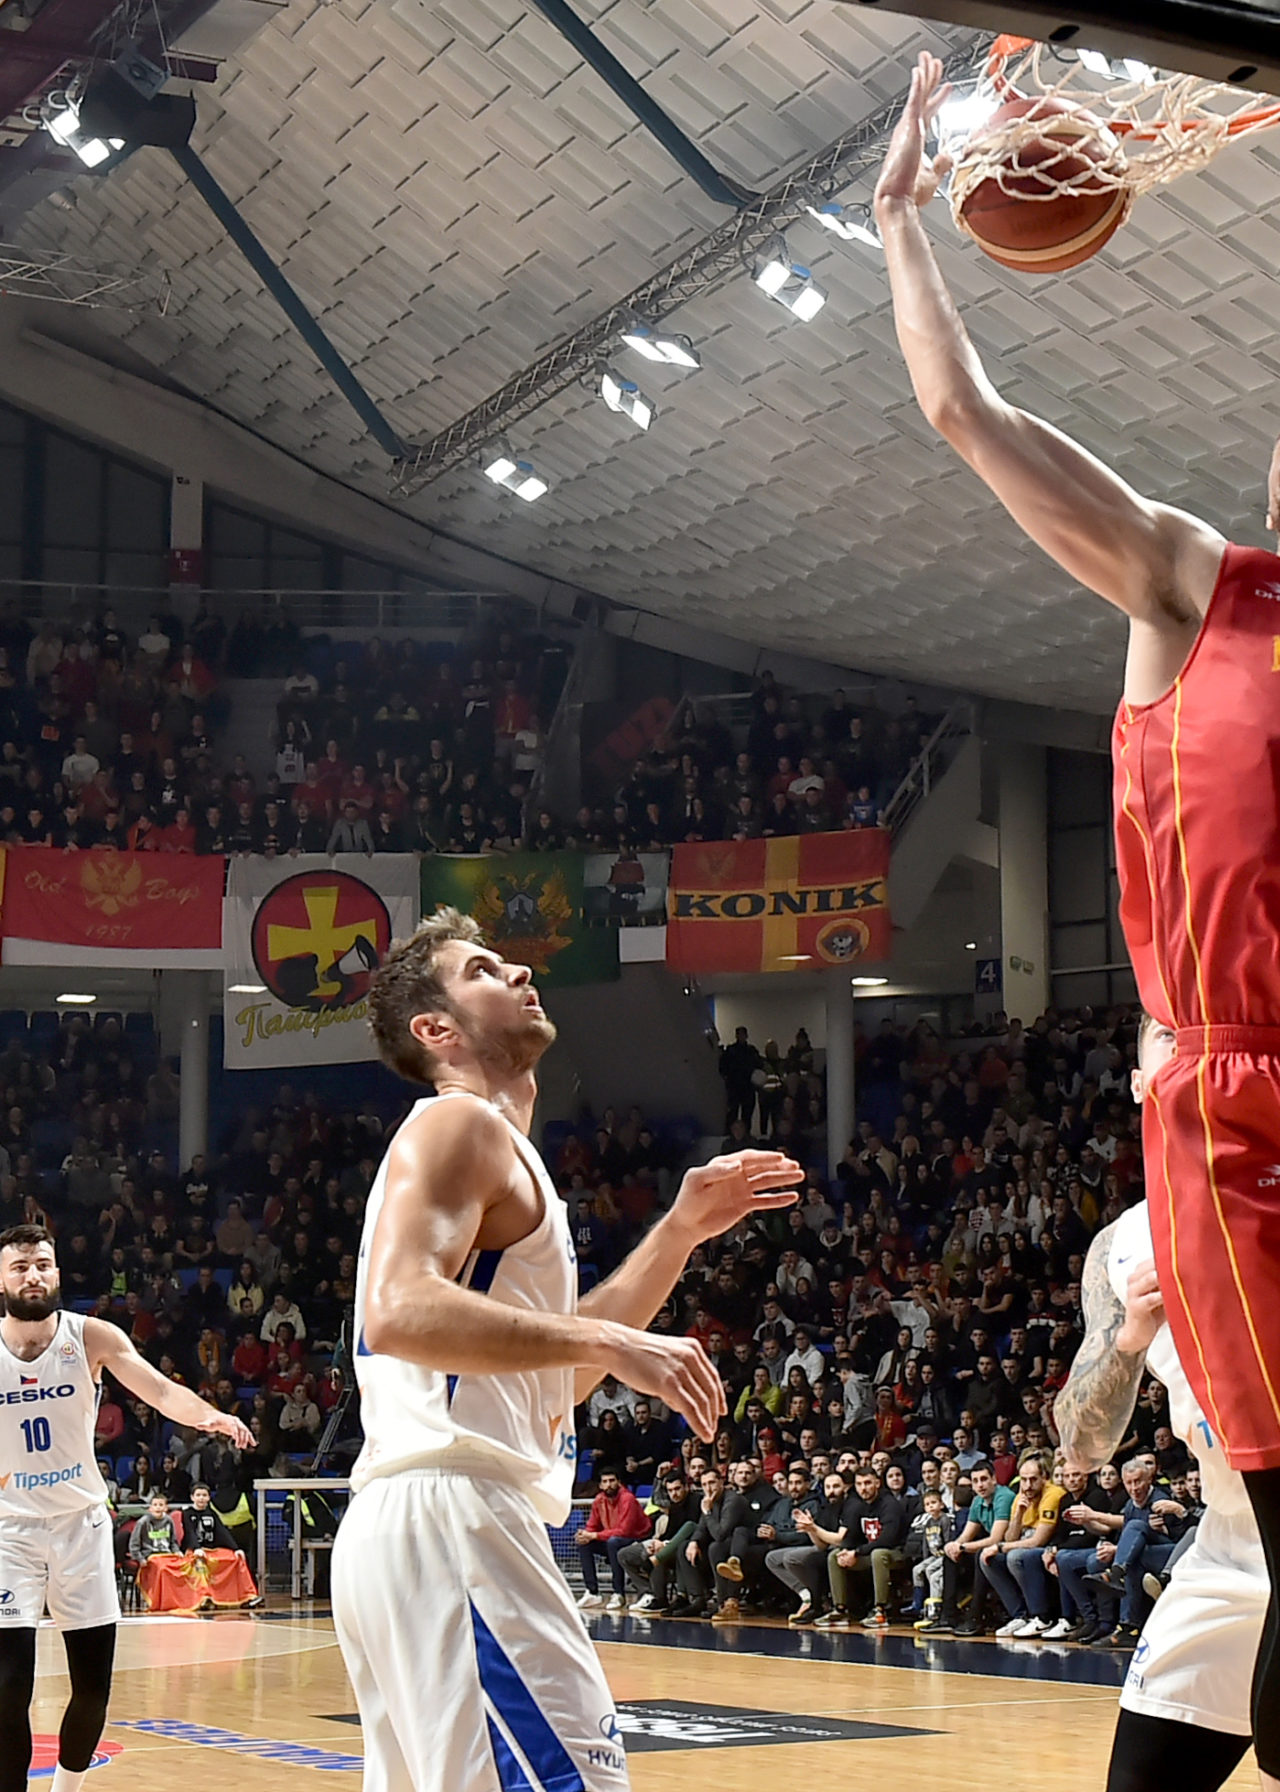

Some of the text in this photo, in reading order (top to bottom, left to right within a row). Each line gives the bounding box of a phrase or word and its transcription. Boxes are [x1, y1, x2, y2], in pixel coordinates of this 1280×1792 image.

[673, 880, 884, 918] KONIK
[981, 961, 997, 983] 4
[0, 1384, 75, 1405] ESKO
[20, 1417, 51, 1453] 10
[14, 1463, 83, 1490] Tipsport
